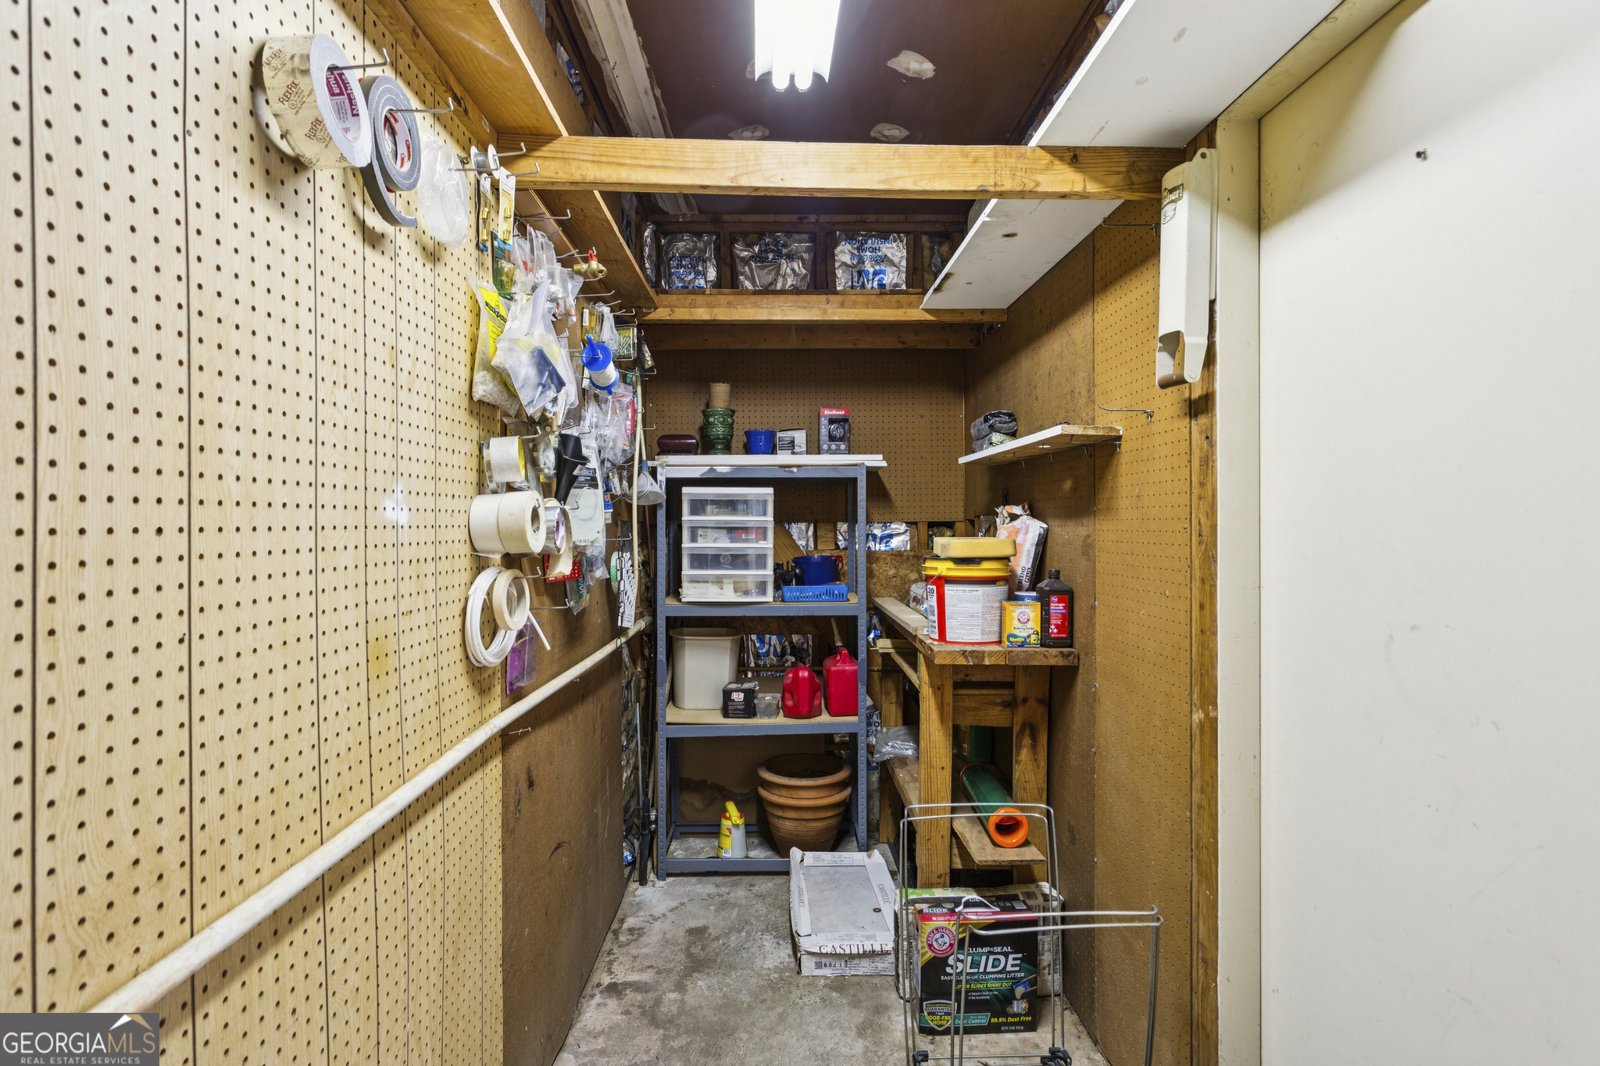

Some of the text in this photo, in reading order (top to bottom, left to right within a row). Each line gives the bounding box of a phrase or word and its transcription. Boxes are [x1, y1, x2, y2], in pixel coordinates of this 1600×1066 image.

[278, 80, 300, 105] FLEXFIX
[305, 117, 323, 141] FLEXFIX
[945, 953, 1023, 974] SLIDE
